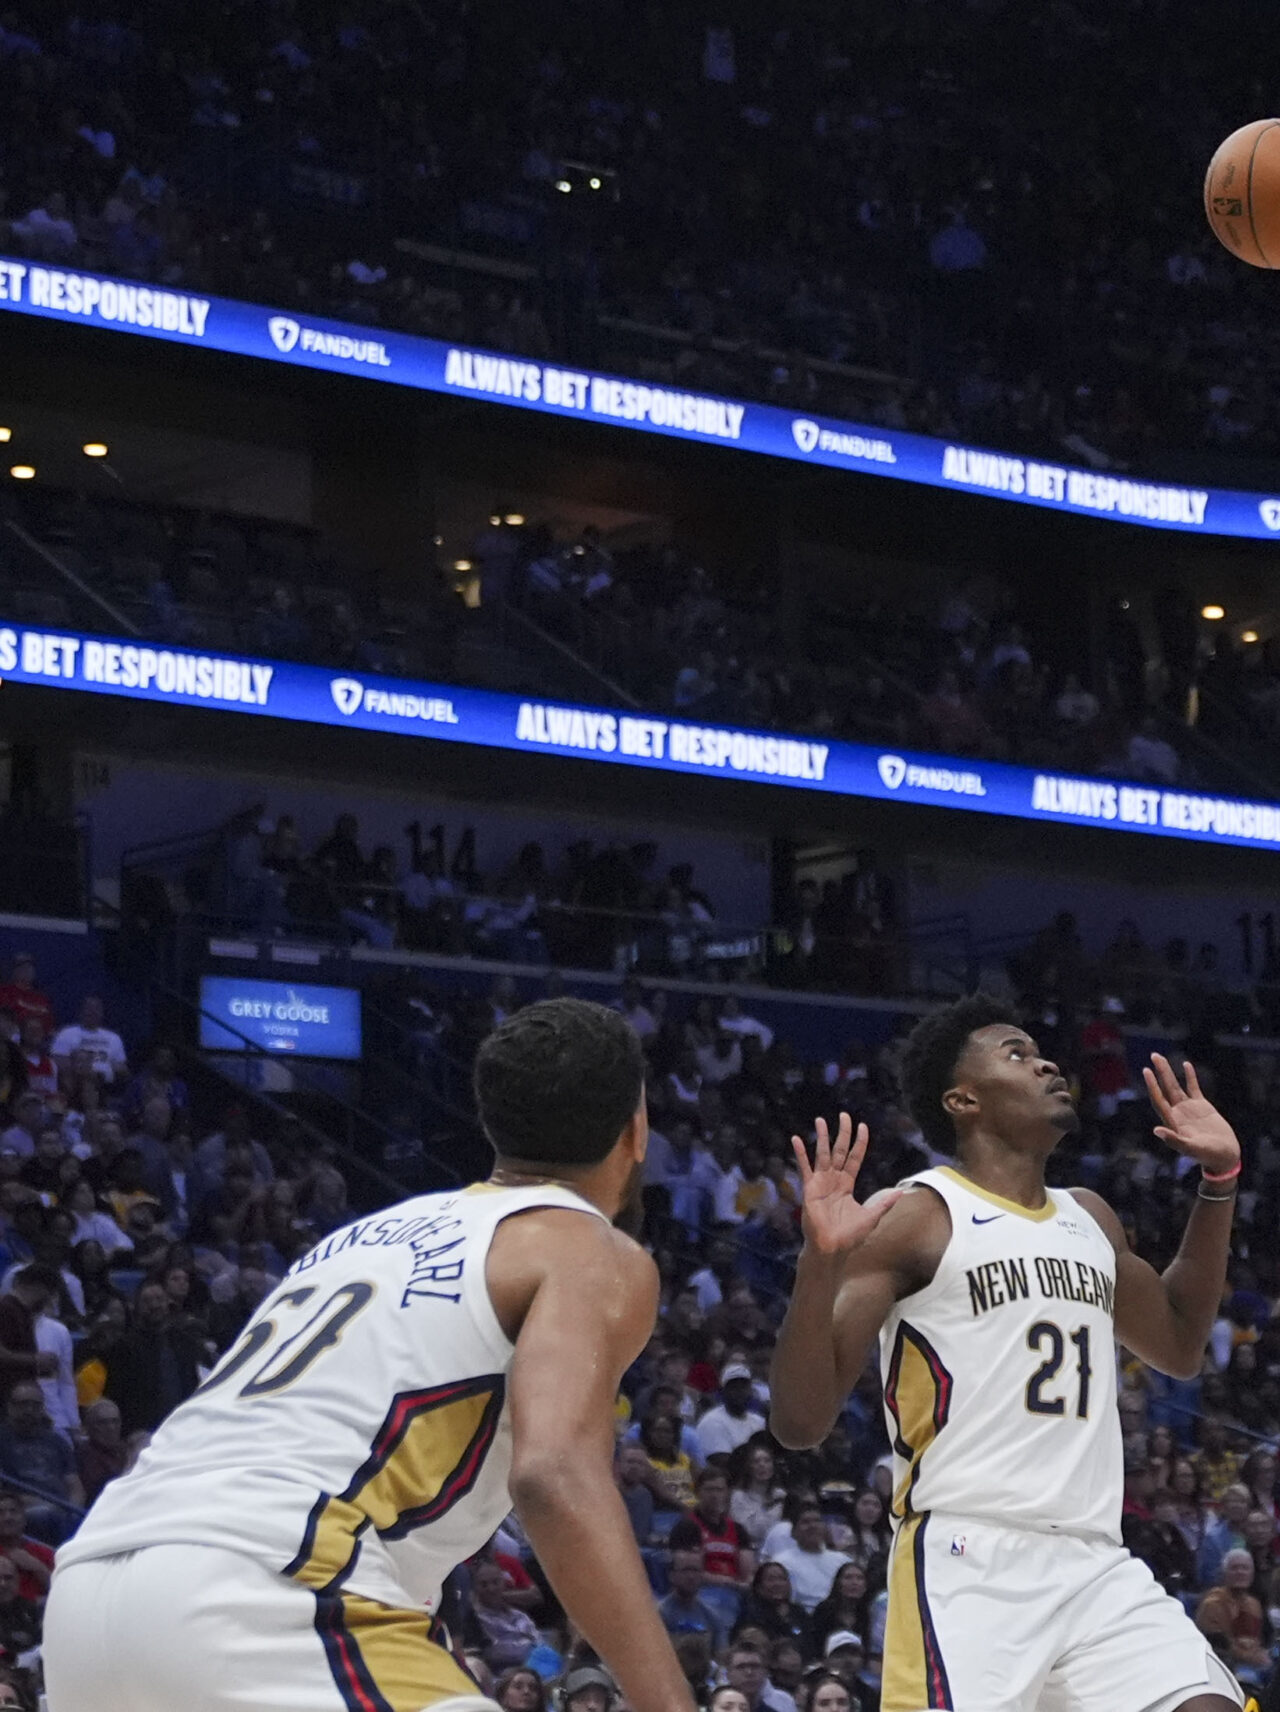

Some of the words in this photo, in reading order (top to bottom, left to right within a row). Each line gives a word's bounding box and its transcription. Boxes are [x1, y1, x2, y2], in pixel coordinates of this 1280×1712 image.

[0, 260, 27, 302] ET
[29, 267, 210, 337] RESPONSIBLY
[300, 329, 391, 367] FANDUEL
[444, 349, 542, 402] ALWAYS
[542, 367, 590, 410] BET
[590, 377, 745, 440] RESPONSIBLY
[816, 425, 897, 464] FANDUEL
[941, 446, 1026, 495] ALWAYS
[1025, 462, 1068, 502] BET
[1067, 471, 1209, 525] RESPONSIBLY
[21, 632, 80, 679] BET
[83, 641, 273, 706] RESPONSIBLY
[363, 689, 459, 724] FANDUEL
[515, 703, 617, 753] ALWAYS
[619, 717, 668, 759] BET
[669, 724, 829, 781] RESPONSIBLY
[904, 763, 986, 796] FANDUEL
[1032, 775, 1118, 820] ALWAYS
[1118, 786, 1161, 825] BET
[230, 1000, 272, 1018] GREY
[274, 1001, 330, 1024] GOOSE
[966, 1257, 1030, 1317] NEW
[1034, 1256, 1115, 1320] ORLEAN
[1025, 1319, 1093, 1422] 21
